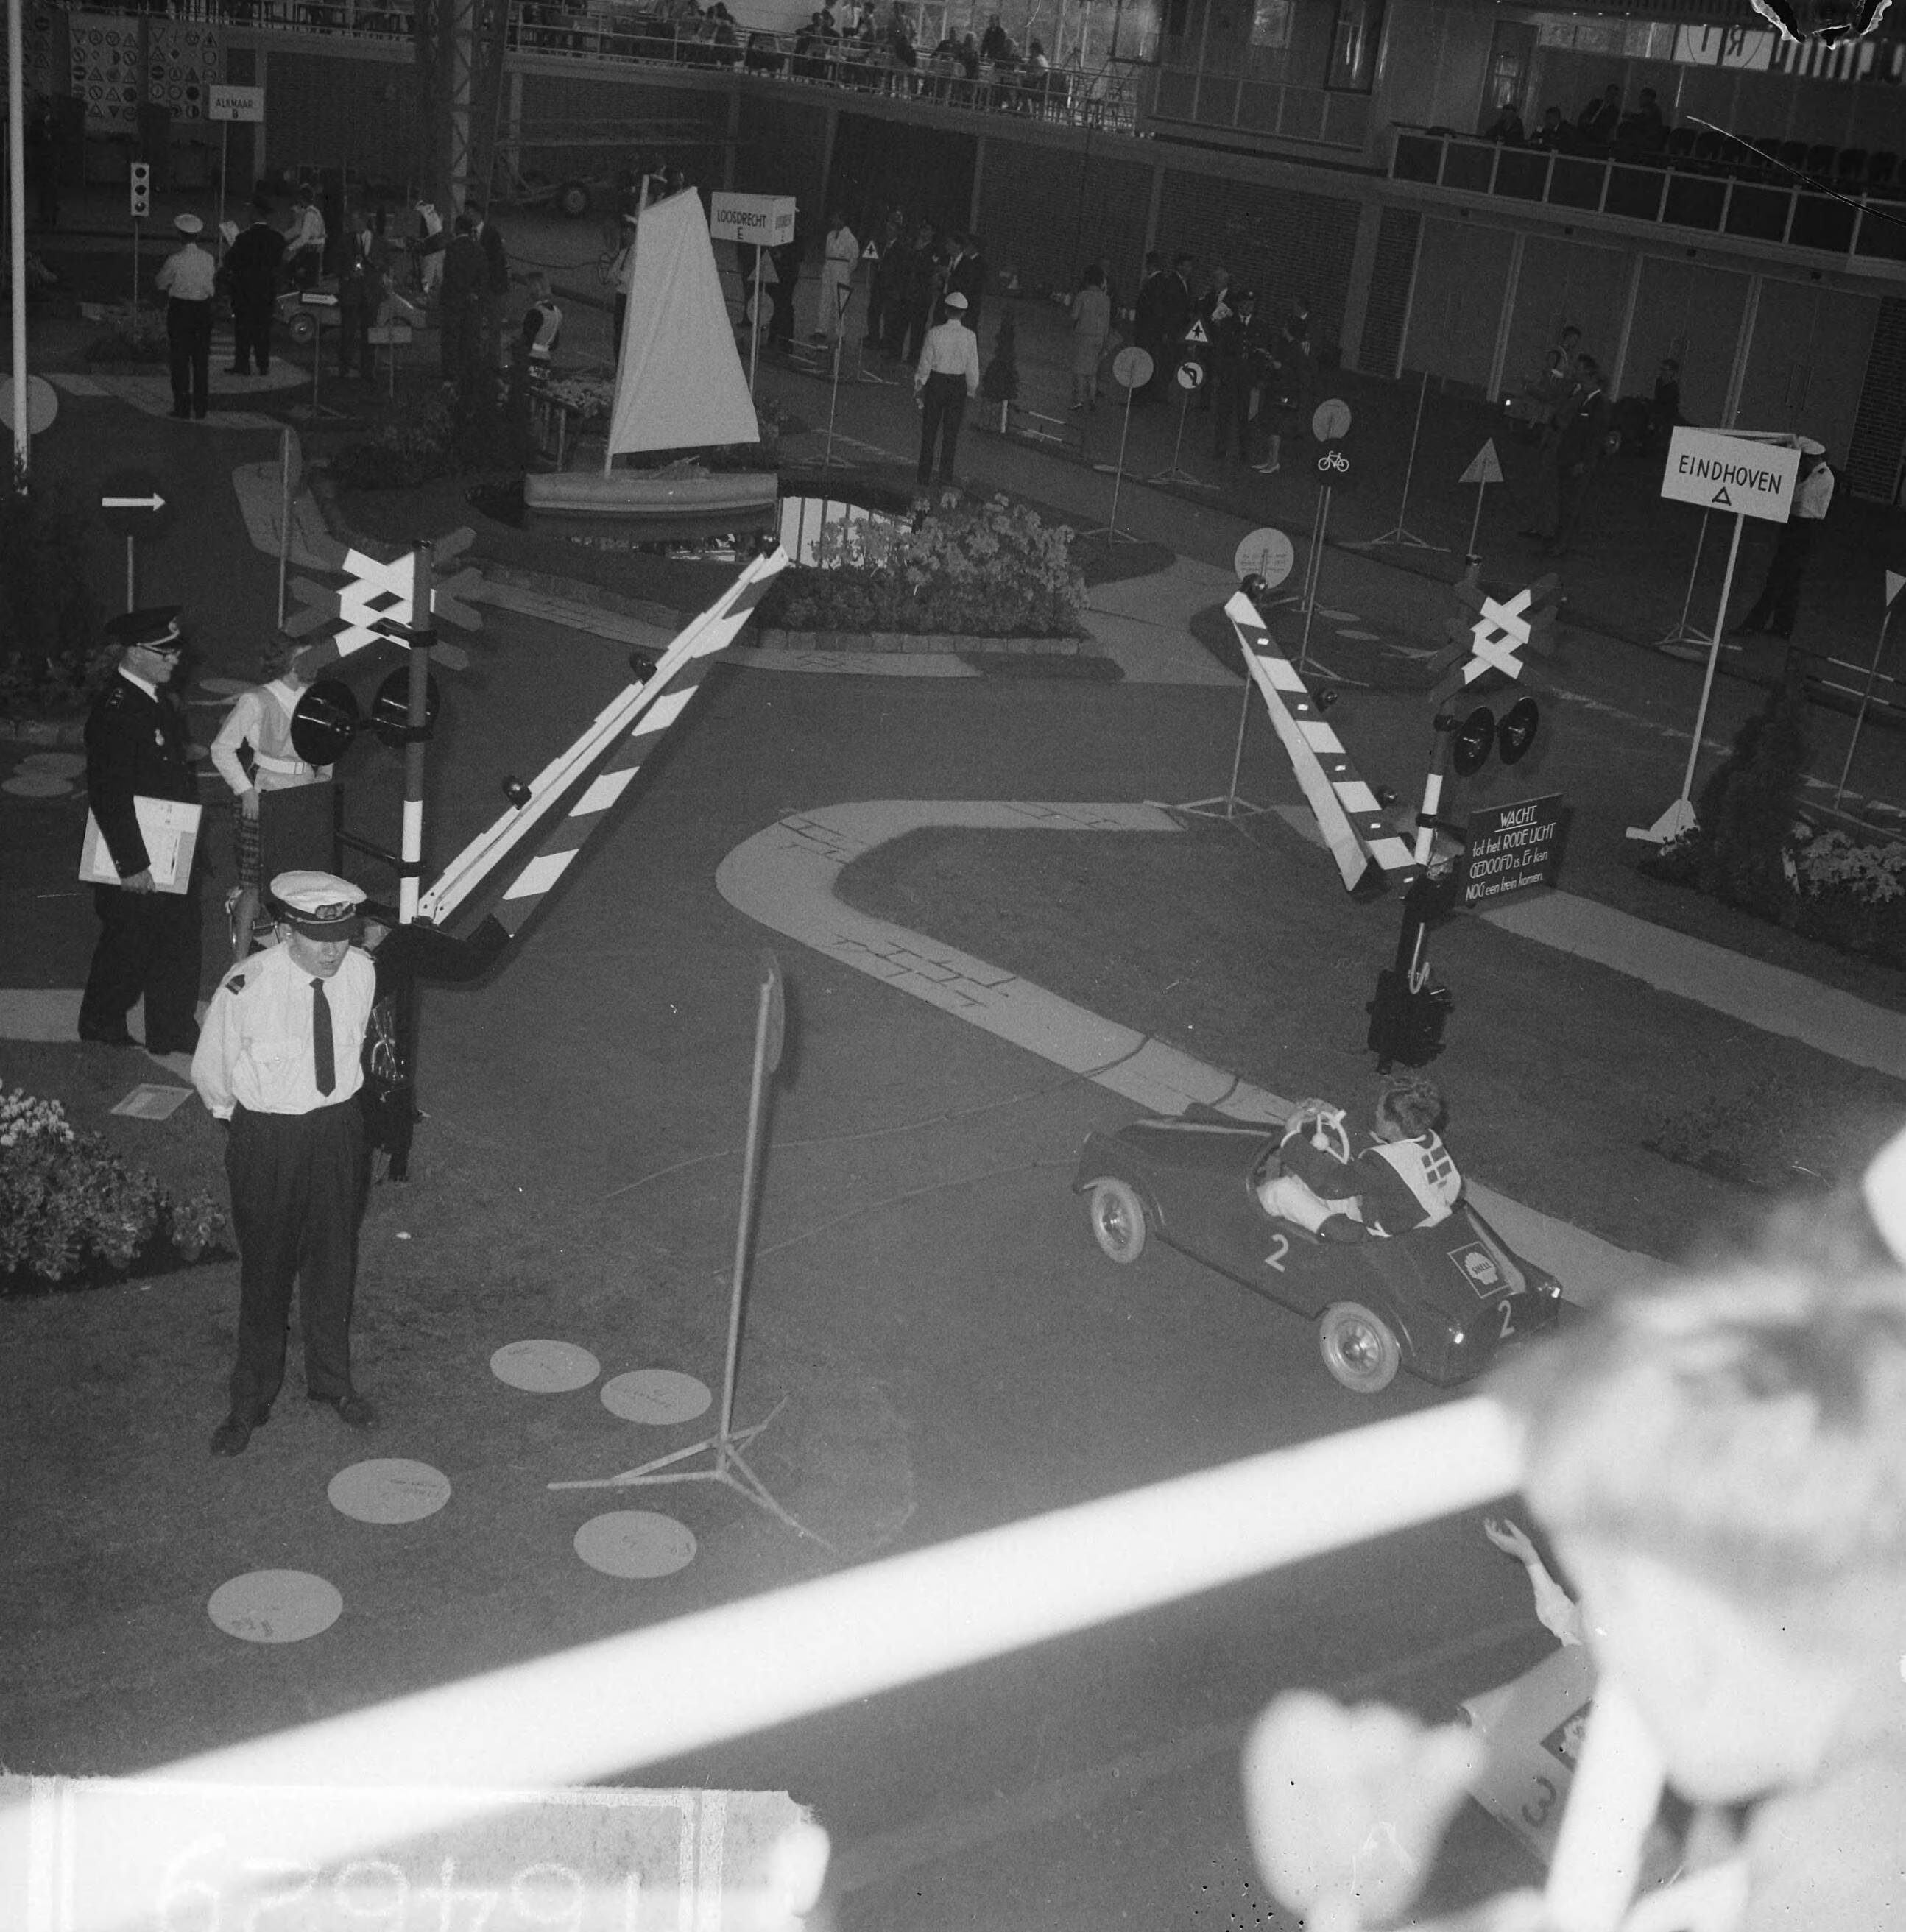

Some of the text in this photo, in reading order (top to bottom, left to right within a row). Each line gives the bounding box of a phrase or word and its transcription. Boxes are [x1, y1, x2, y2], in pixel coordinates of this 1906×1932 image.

[717, 209, 767, 228] LOOSDRECHT
[737, 226, 744, 240] E
[1679, 454, 1782, 495] EINDHOVEN
[1500, 805, 1538, 828] WACHT
[1472, 822, 1556, 857] tot het RODE LICHT
[1469, 854, 1513, 879] GEDOOFD
[1533, 847, 1548, 863] kan
[1465, 881, 1486, 902] NOG
[1485, 883, 1500, 896] een
[1500, 876, 1517, 892] trein
[1264, 1234, 1289, 1273] 2
[1471, 1261, 1492, 1275] SHELL
[1498, 1300, 1515, 1338] 2
